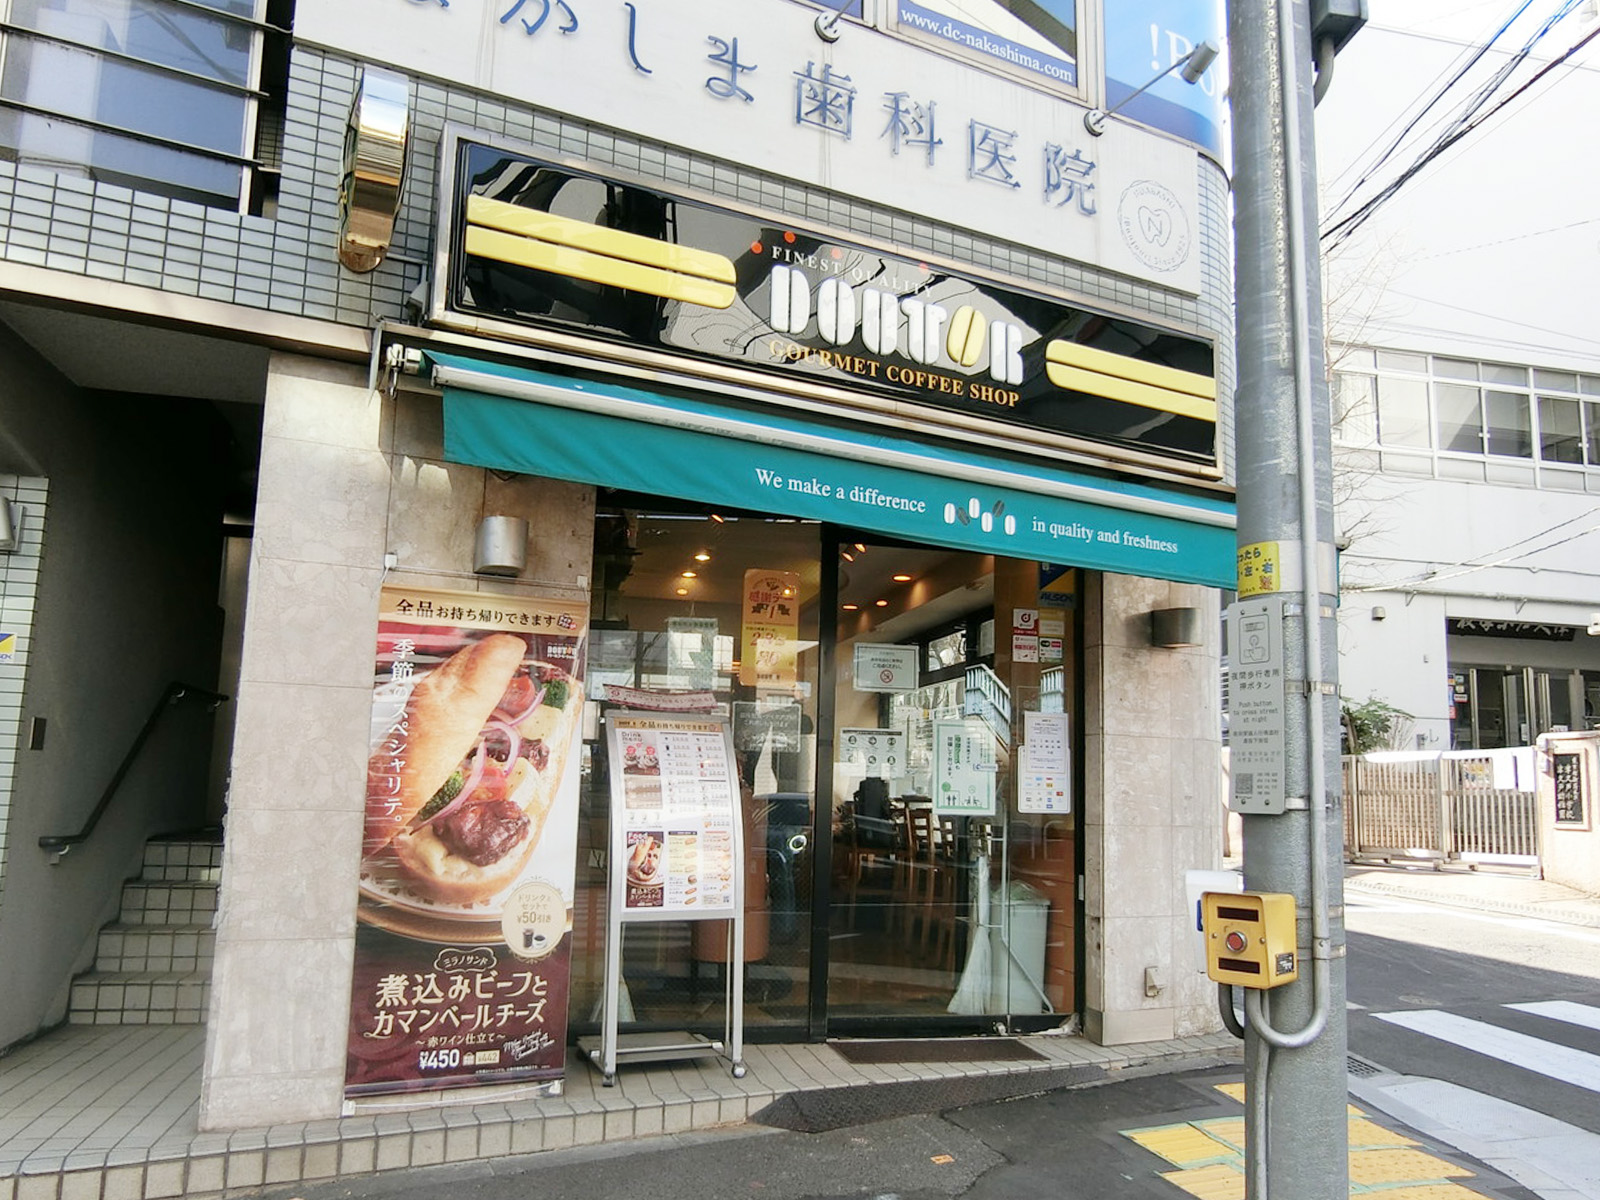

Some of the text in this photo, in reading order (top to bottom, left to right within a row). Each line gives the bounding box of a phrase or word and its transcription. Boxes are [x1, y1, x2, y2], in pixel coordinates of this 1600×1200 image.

[900, 9, 1073, 83] www.dc-nakashima.com
[415, 0, 1097, 216] かしま歯科医院
[772, 245, 933, 298] FINEST QUALITY
[770, 264, 1024, 386] DOUTOR
[769, 339, 1020, 408] GOURMET COFFEE SHOP
[755, 467, 1178, 554] We make a difference in quality and freshness
[396, 598, 556, 627] 全品お持ち帰りできます
[383, 638, 416, 823] 季節のスペシャリテ。
[363, 998, 548, 1039] カマンベールチーズ
[375, 970, 548, 1008] 煮込みビーフと
[419, 1049, 460, 1070] ¥450
